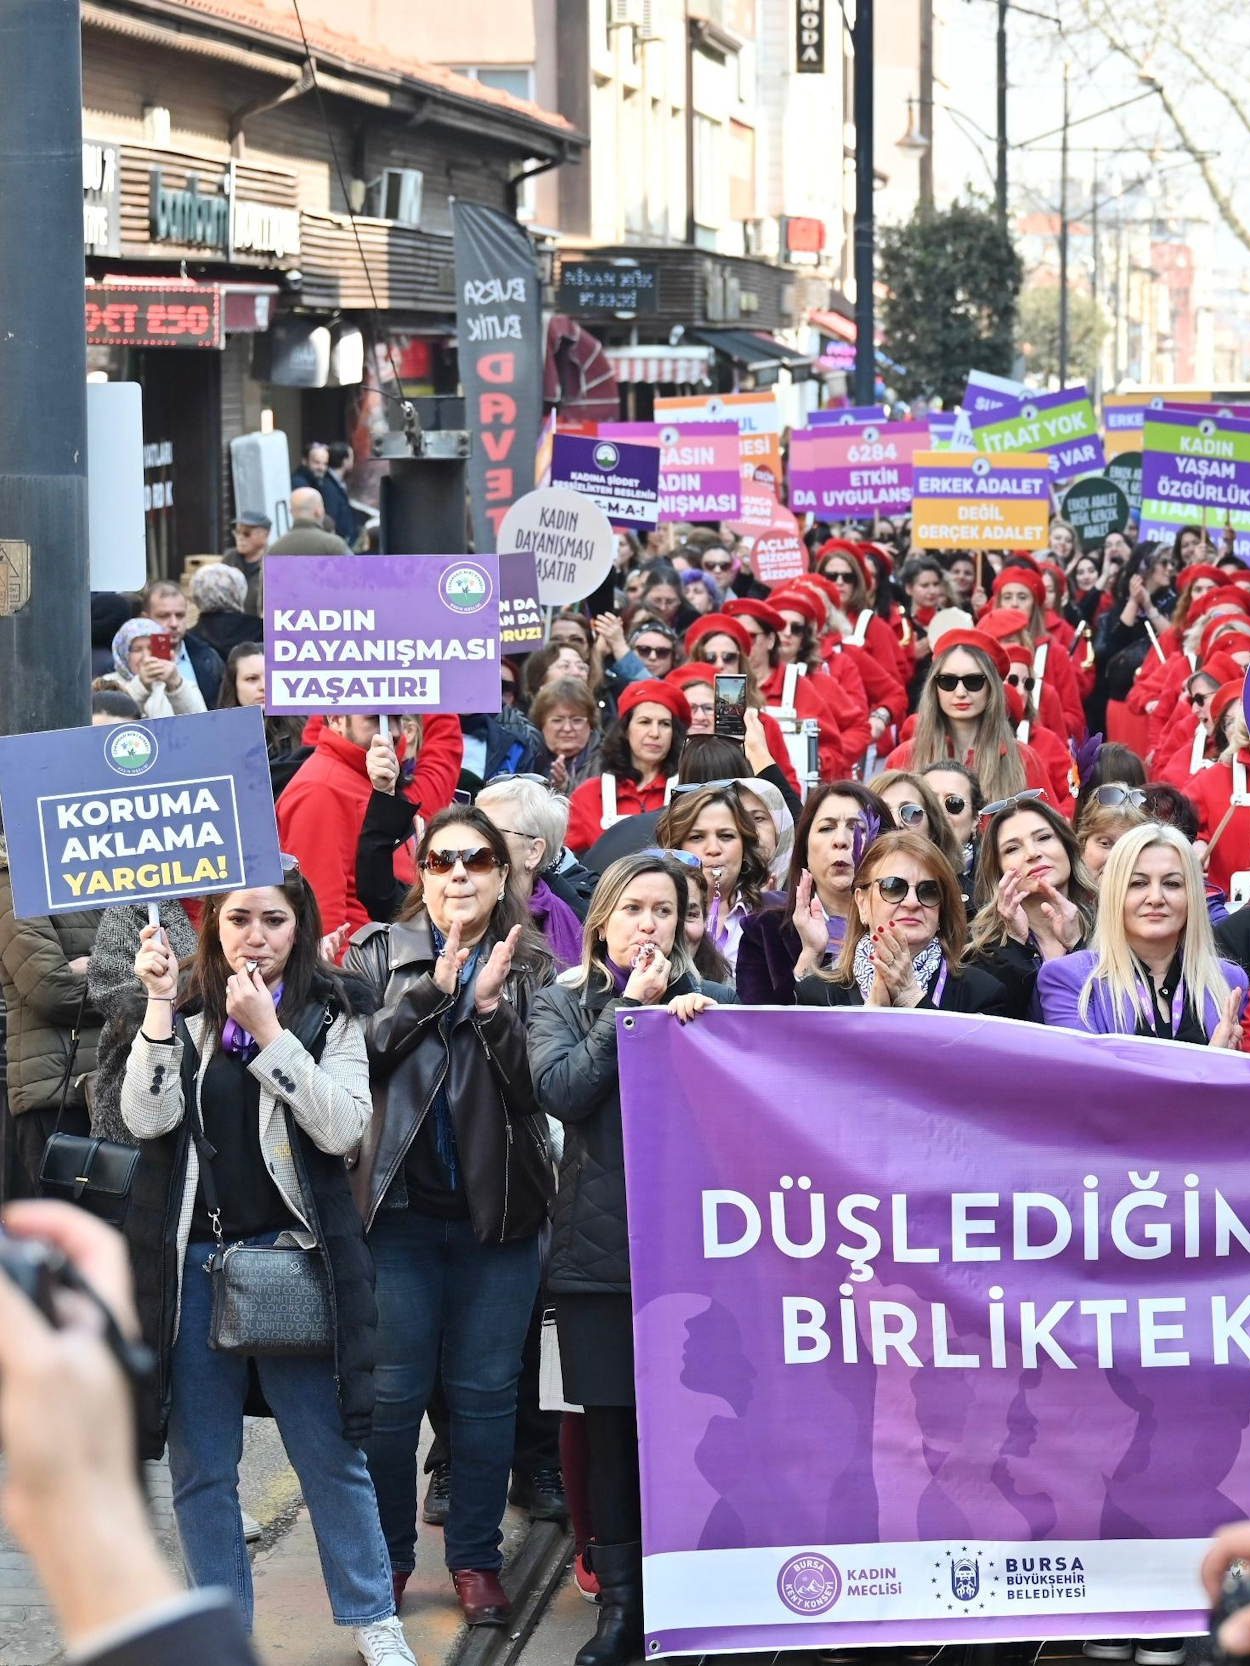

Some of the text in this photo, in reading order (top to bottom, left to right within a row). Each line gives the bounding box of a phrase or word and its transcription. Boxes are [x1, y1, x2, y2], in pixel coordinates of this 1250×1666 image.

[1108, 413, 1144, 428] ERKE
[982, 411, 1088, 452] İTAAT YOK
[847, 442, 897, 462] 6284
[1060, 444, 1097, 467] VAR
[1180, 436, 1234, 457] KADIN
[570, 471, 640, 487] KADINA ŞİDDET
[850, 466, 899, 487] ETKİN
[1175, 456, 1236, 481] YAŞAM
[658, 474, 700, 491] ADIN
[919, 478, 1043, 494] ERKEK ADALET
[1158, 476, 1250, 506] ÖZGÜRLÜK
[658, 494, 737, 517] NIŞMASI
[823, 486, 913, 506] UYGULANS
[539, 506, 578, 532] KADIN
[958, 503, 1004, 521] DEĞİL
[515, 529, 594, 562] DAYANIŞMASI
[757, 537, 799, 553] AÇLIK
[918, 526, 1042, 544] GERÇEK ADALET
[536, 557, 577, 584] AŞATIR
[274, 610, 375, 631] KADIN
[274, 639, 495, 667] DAYANIŞMASI
[282, 676, 427, 704] YAŞATIR!
[57, 788, 220, 829] KORUMA
[61, 821, 224, 864] AKLAMA
[63, 855, 228, 897] YARGILA!
[782, 1282, 1191, 1369] BİRLİKTE
[793, 1560, 824, 1572] BURSA
[847, 1567, 897, 1581] KADIN
[1006, 1557, 1084, 1572] BURSA
[847, 1582, 902, 1596] MECLİSİ
[1007, 1572, 1085, 1587] BÜYÜKŞEHİR
[785, 1583, 803, 1605] KENT
[1007, 1585, 1086, 1600] BELEDİYESİ
